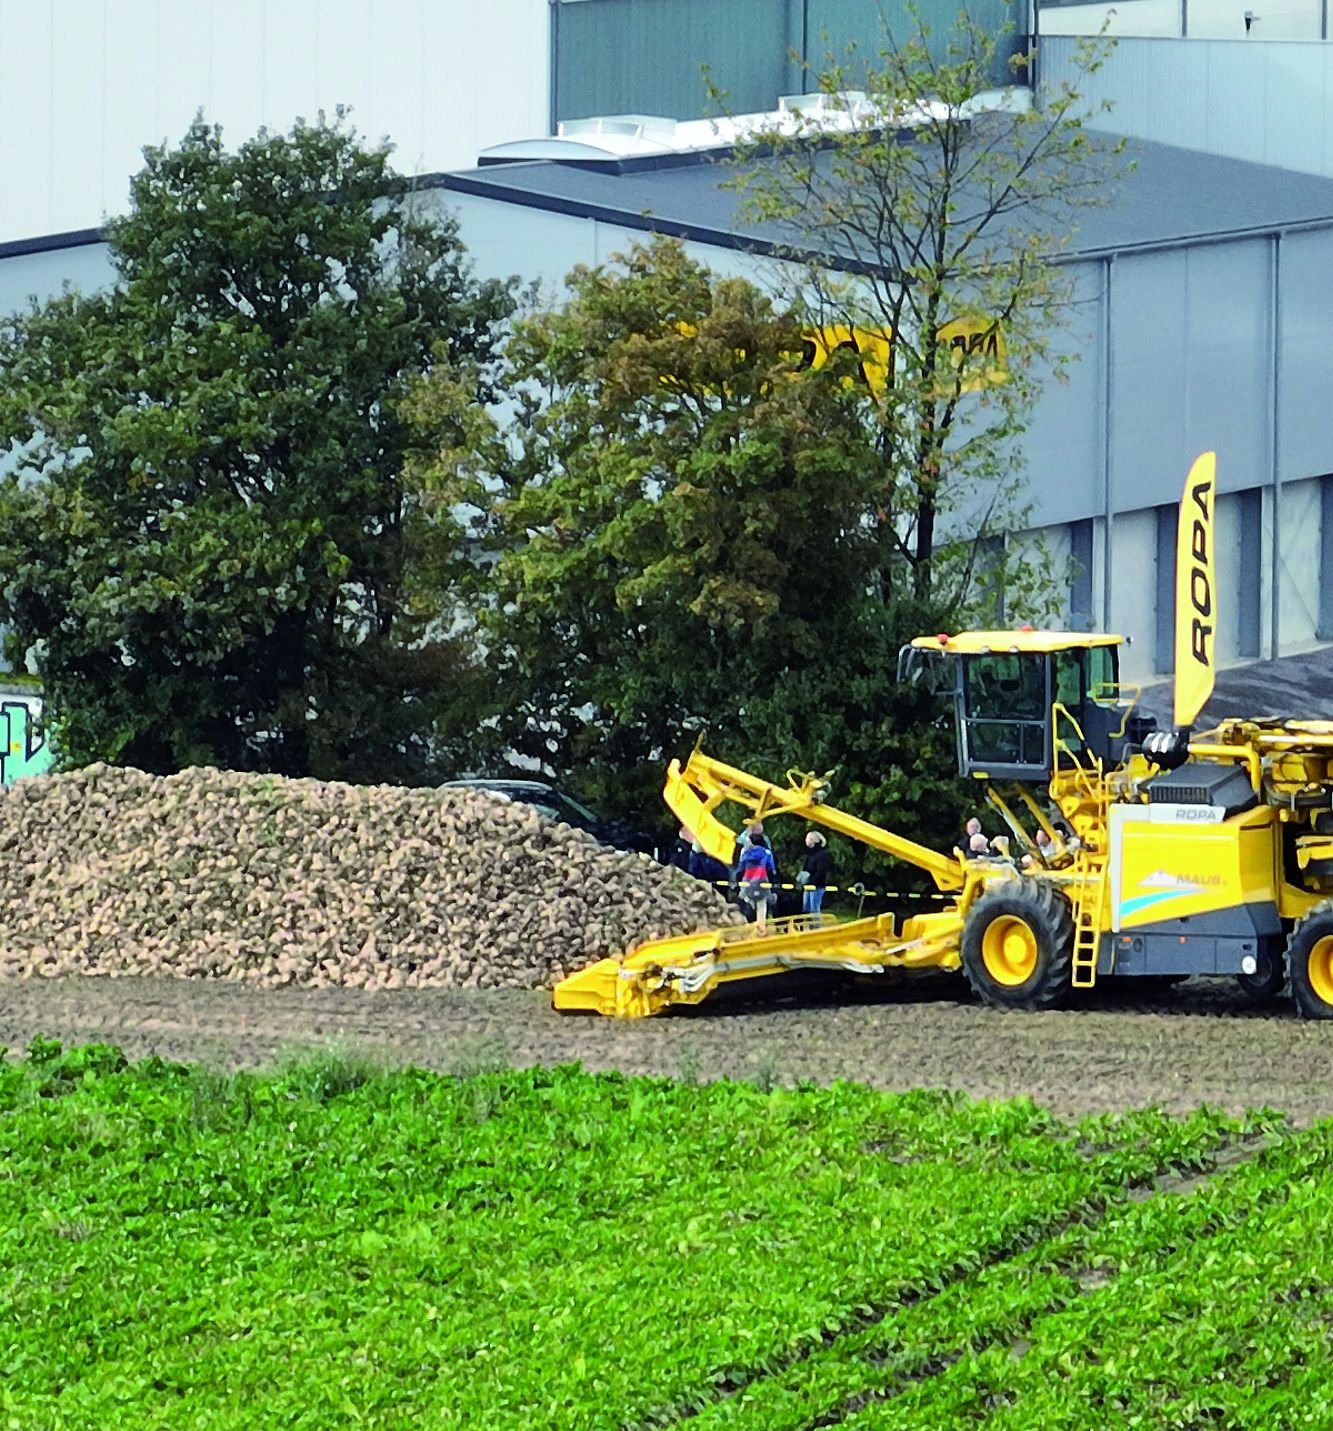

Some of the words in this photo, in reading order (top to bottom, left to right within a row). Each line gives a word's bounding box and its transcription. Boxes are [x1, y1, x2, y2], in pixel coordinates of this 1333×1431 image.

[1191, 481, 1213, 667] ROPA
[1176, 808, 1217, 821] ROPA
[1176, 874, 1221, 885] MAUS
